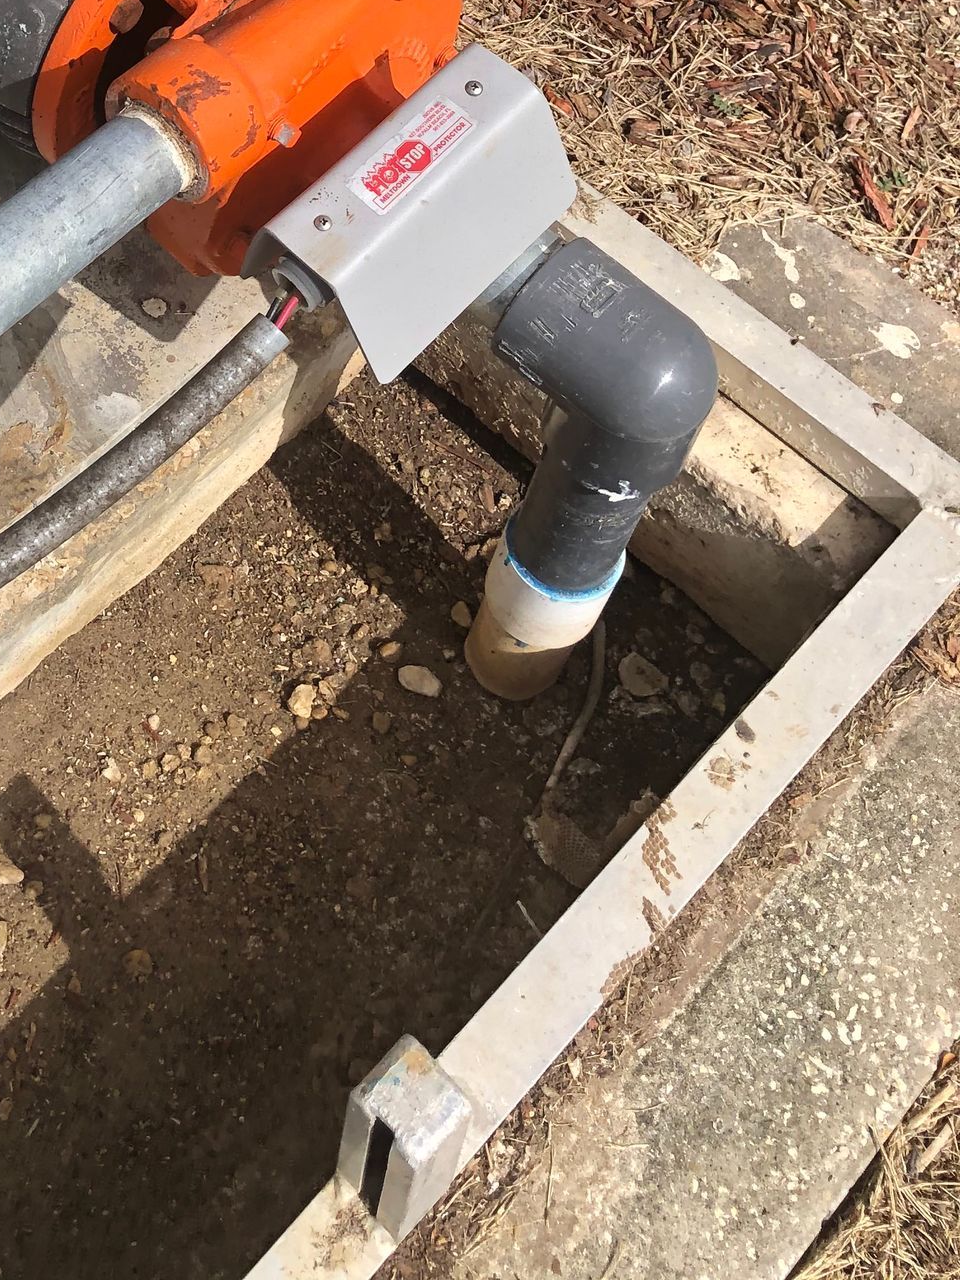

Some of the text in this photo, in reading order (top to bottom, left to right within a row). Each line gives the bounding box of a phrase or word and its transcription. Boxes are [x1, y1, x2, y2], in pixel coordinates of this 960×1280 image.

[363, 141, 428, 198] HOT STOP
[379, 120, 466, 204] MELTDOWN PROTECTOR
